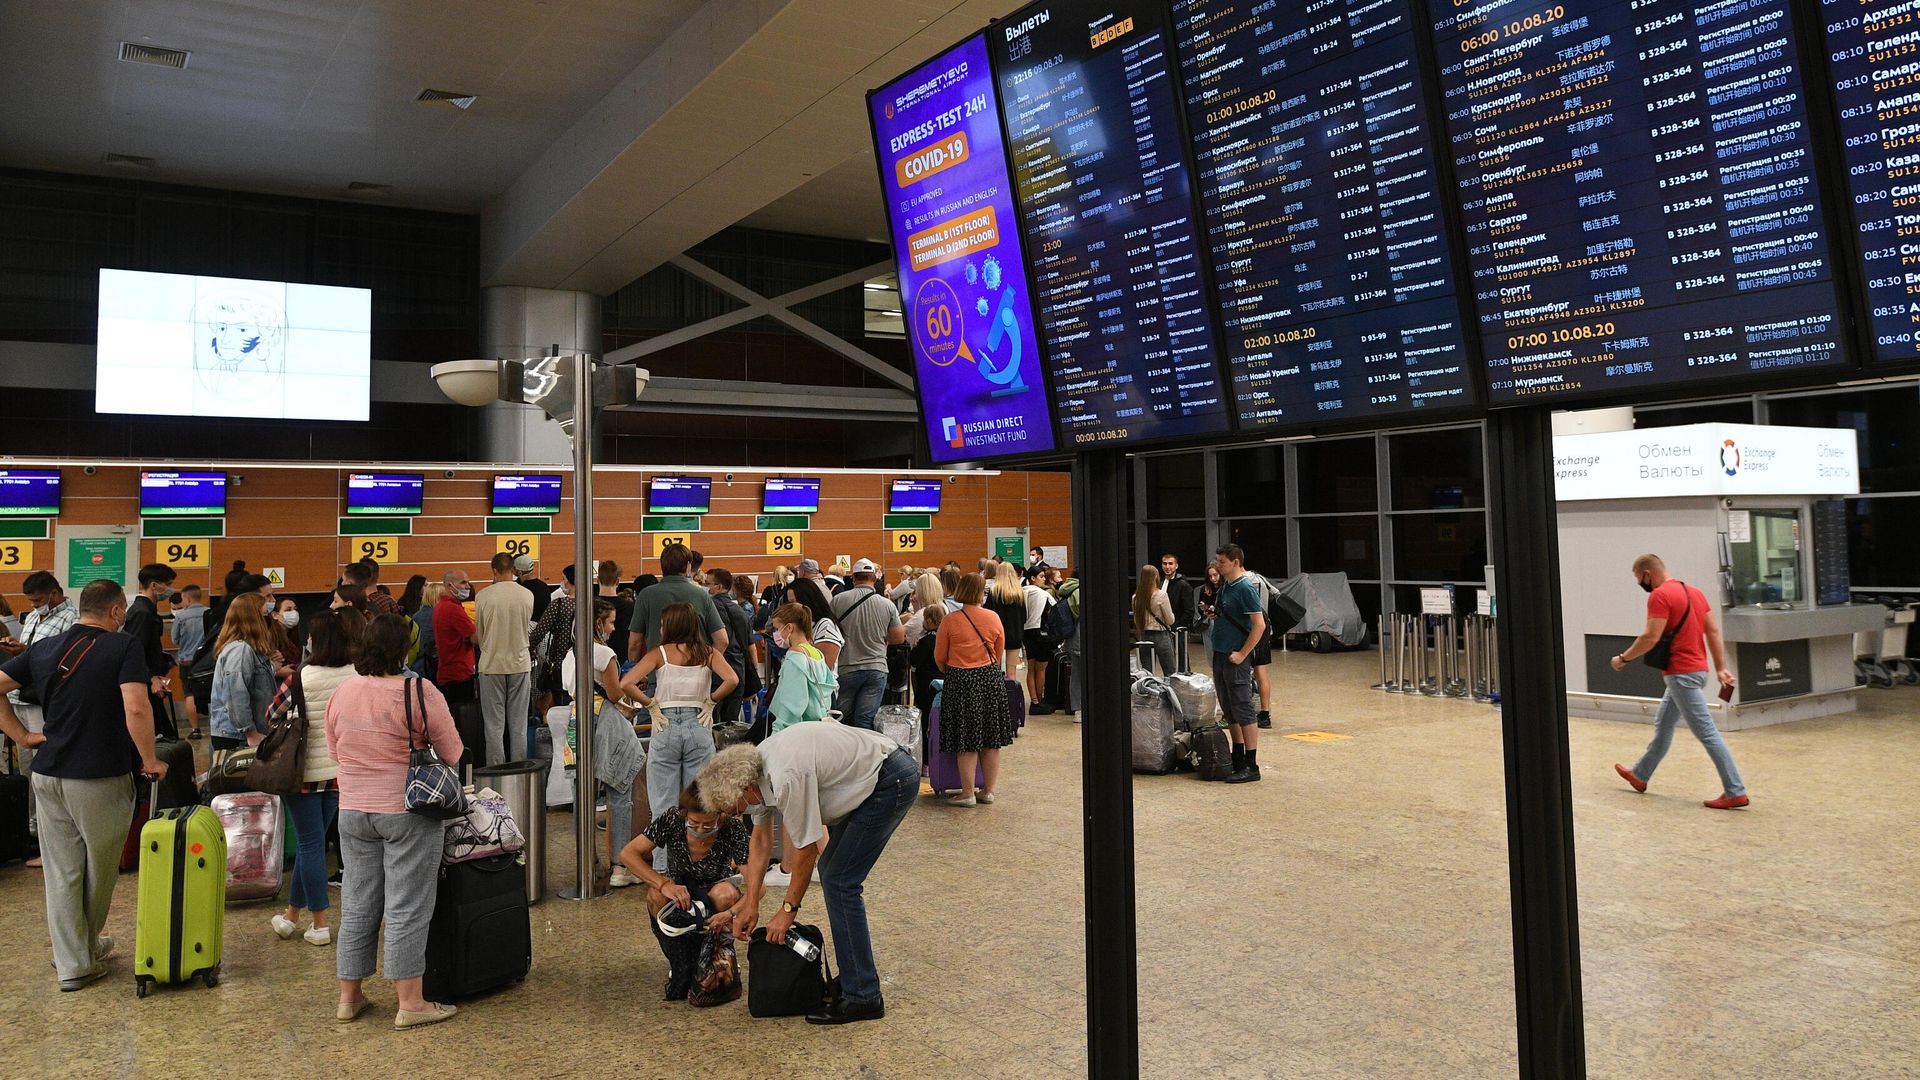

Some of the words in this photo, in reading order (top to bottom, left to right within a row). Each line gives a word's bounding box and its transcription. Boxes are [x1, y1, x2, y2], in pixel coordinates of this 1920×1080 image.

[1005, 9, 1050, 42] Вылеты
[1088, 13, 1113, 28] Терминалы
[1190, 11, 1206, 24] Сочи
[1316, 16, 1342, 31] 317-364
[1635, 26, 1642, 35] B
[1643, 12, 1684, 33] 328-364
[1827, 17, 1859, 33] 08:10
[1864, 14, 1912, 34] SU1332
[1351, 21, 1386, 40] Регистрация
[1387, 14, 1402, 28] идет
[1460, 30, 1499, 52] 06:00
[1503, 5, 1565, 38] 10.08.20
[1551, 16, 1590, 38] 圣彼得堡
[1698, 22, 1750, 43] Регистрация
[1758, 10, 1784, 24] 00:00
[1193, 30, 1210, 43] Омск
[1009, 34, 1032, 62] 出港
[1196, 43, 1227, 61] Оренбург
[1464, 33, 1544, 68] Санкт-Петербург
[1014, 69, 1033, 85] 22:16
[1034, 54, 1063, 75] 09.08.20
[1200, 56, 1244, 80] Магнитогорск
[1442, 62, 1462, 76] 06:00
[1464, 63, 1490, 77] SU002
[1492, 51, 1523, 68] AZ5339
[1467, 67, 1522, 91] Н.Новгород
[1468, 84, 1498, 100] SU1228
[1501, 73, 1533, 89] AZ5228
[1535, 62, 1568, 77] KL3254
[1570, 50, 1605, 66] AF4924
[896, 62, 968, 107] SHEREMETYEVO
[897, 87, 941, 113] INTERNATIONAL
[943, 72, 968, 89] AIRPORT
[1202, 87, 1219, 99] Орск
[1206, 106, 1232, 124] 01:00
[1235, 89, 1276, 115] 10.08.20
[1471, 91, 1522, 114] Краснодар
[1877, 92, 1920, 111] Анапа
[1841, 103, 1873, 118] 08:15
[891, 105, 961, 153] EXPRESS-TEST
[964, 94, 986, 117] 24H
[1209, 112, 1262, 137] Ханты-Мансийск
[1474, 124, 1497, 137] Сочи
[1212, 137, 1249, 156] Красноярск
[1478, 135, 1544, 160] Симферополь
[1846, 132, 1878, 147] 08:20
[905, 140, 963, 178] COVID-19
[1215, 154, 1257, 175] Новосибирск
[1482, 163, 1527, 183] Оренбург
[1574, 168, 1603, 183] 阿纳帕
[1218, 180, 1244, 193] Барнаул
[911, 199, 917, 207] EU
[918, 188, 942, 205] APPROVED
[914, 210, 934, 225] RESULTS
[935, 208, 940, 217] IN
[940, 200, 962, 215] RUSSIAN
[962, 196, 973, 207] AND
[974, 186, 998, 202] ENGLISH
[1222, 193, 1266, 212] Симферополь
[1485, 192, 1514, 206] Анапа
[1224, 220, 1246, 231] Пермь
[1489, 212, 1528, 228] Саратов
[1582, 214, 1620, 232] 格连吉克
[912, 234, 943, 250] TERMINAL
[944, 230, 948, 240] B
[949, 224, 963, 238] (1ST
[964, 215, 990, 232] FLOOR)
[914, 247, 946, 264] TERMINAL
[946, 244, 952, 253] D
[953, 238, 968, 252] (2ND
[970, 228, 995, 245] FLOOR)
[1043, 239, 1062, 252] 23:00
[1228, 237, 1254, 250] Иркутск
[1492, 232, 1547, 252] Геленджик
[1231, 258, 1252, 271] Сургут
[1496, 254, 1559, 274] Калининград
[1590, 264, 1628, 281] 苏尔古特
[1234, 278, 1248, 288] Уфа
[1869, 276, 1901, 288] 08:30
[921, 293, 937, 306] Results
[938, 290, 946, 300] in
[1500, 284, 1531, 299] Сургут
[1237, 294, 1263, 306] Анталья
[1240, 308, 1292, 325] Нижневартовск
[1504, 301, 1570, 320] Екатеринбург
[927, 304, 952, 340] 60
[1244, 336, 1270, 349] 02:00
[1273, 327, 1316, 345] 10.08.20
[1368, 332, 1387, 342] 93-99
[1508, 332, 1548, 350] 07:00
[1552, 322, 1615, 343] 10.08.20
[1602, 336, 1650, 352] 下卡姆斯克
[1878, 334, 1910, 345] 08:40
[929, 340, 955, 353] minutes
[1511, 349, 1573, 365] Нижнекамск
[1806, 352, 1830, 362] 01:10
[1250, 370, 1271, 380] Новый
[1271, 365, 1300, 378] Уренгой
[1492, 380, 1512, 390] 07:10
[1515, 374, 1564, 389] Мурманск
[1516, 385, 1547, 395] SU1320
[1550, 381, 1582, 392] KL2854
[963, 420, 995, 433] RUSSIAN
[996, 416, 1024, 428] DIRECT
[965, 433, 1006, 446] INVESTMENT
[1007, 430, 1027, 441] FUND
[1075, 433, 1095, 442] 00:00
[1098, 429, 1128, 440] 10.08.20
[1638, 444, 1692, 458] Обмен
[1744, 447, 1775, 460] Exchange
[1639, 465, 1703, 479] Валюты
[1744, 460, 1768, 471] Express
[1555, 469, 1588, 479] xpress
[505, 540, 530, 554] 96
[774, 536, 793, 550] 98
[899, 534, 917, 548] 99
[0, 546, 20, 565] 3
[168, 544, 198, 562] 94
[362, 542, 388, 558] 95
